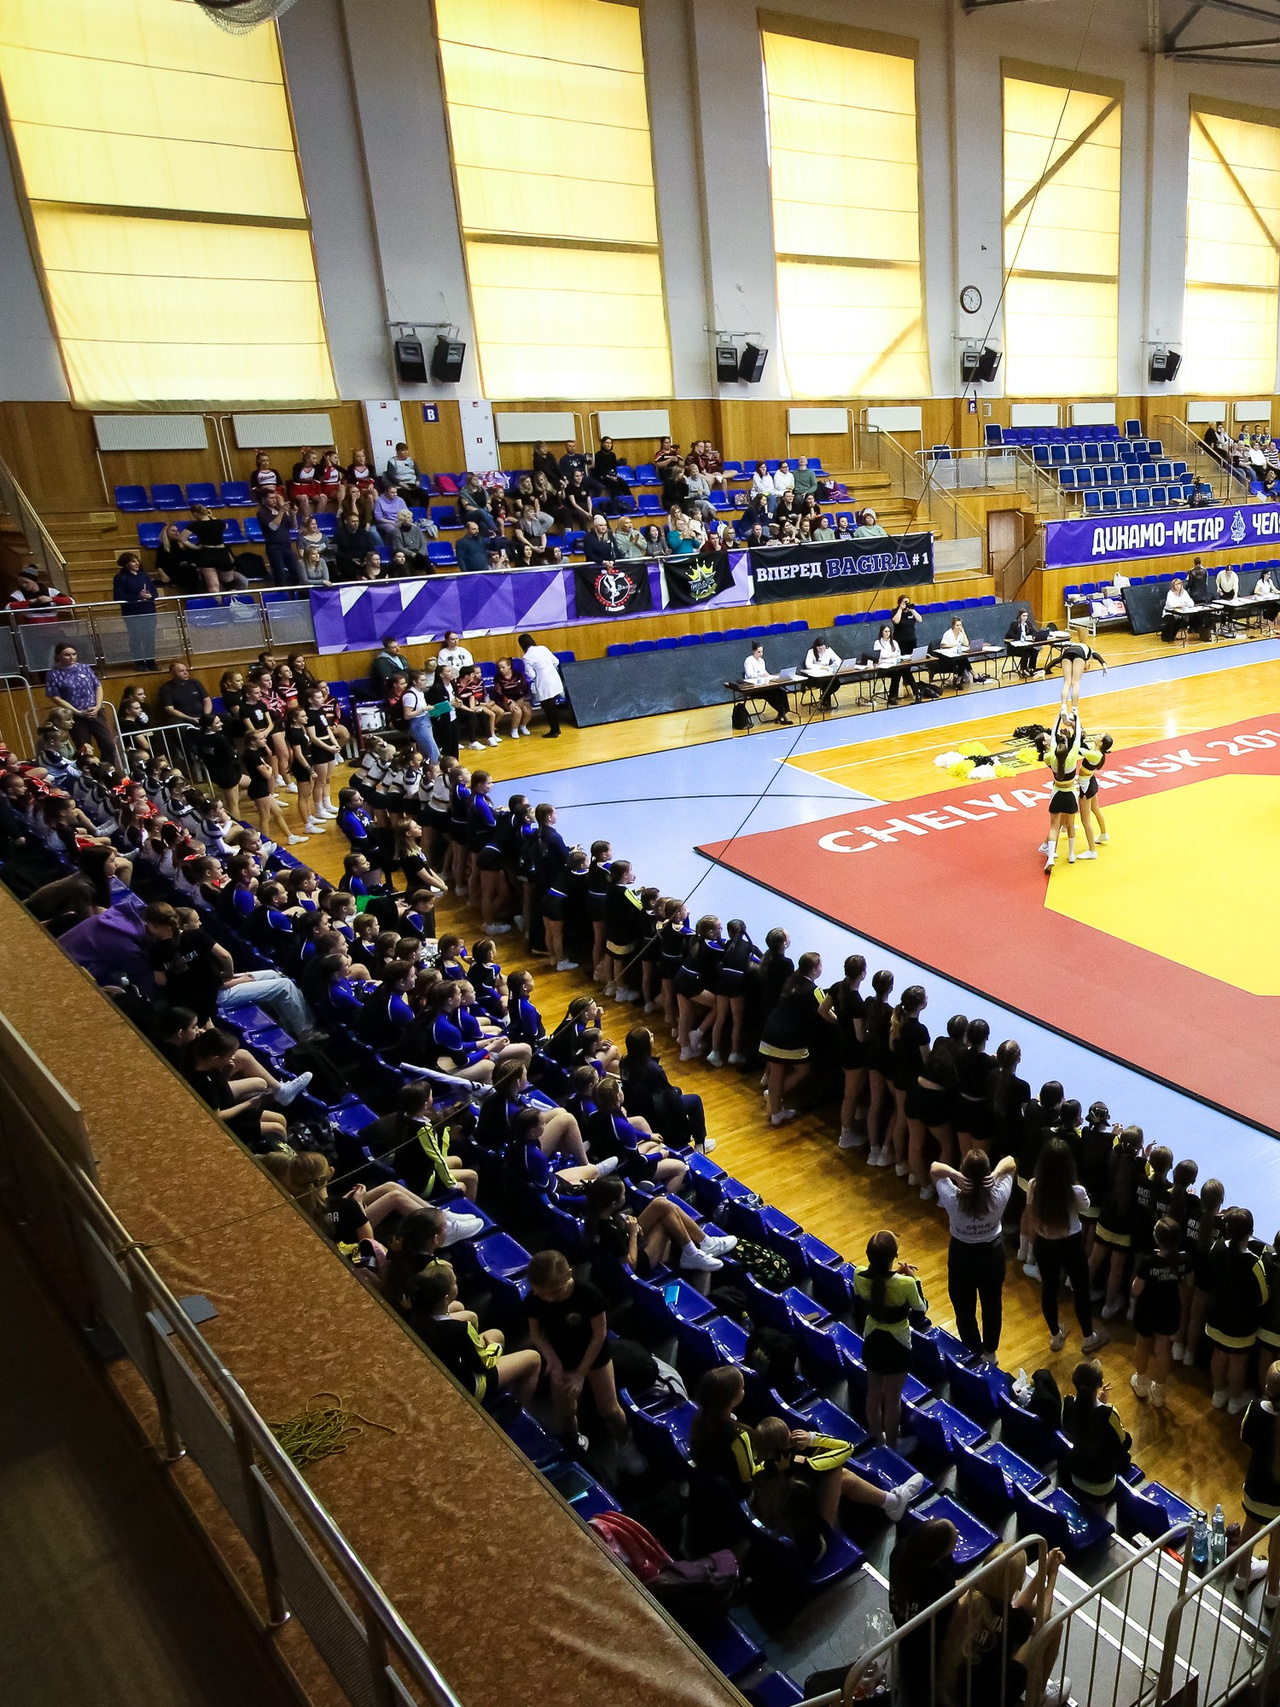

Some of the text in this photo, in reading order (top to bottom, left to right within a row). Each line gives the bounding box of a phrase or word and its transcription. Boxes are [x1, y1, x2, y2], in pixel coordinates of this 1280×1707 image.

[1092, 516, 1225, 555] ДИНАМО-МЕТАР
[756, 561, 823, 582] ВПЕРЕД
[825, 551, 911, 579] BAGIRA
[818, 748, 1222, 853] CHELYAINSK
